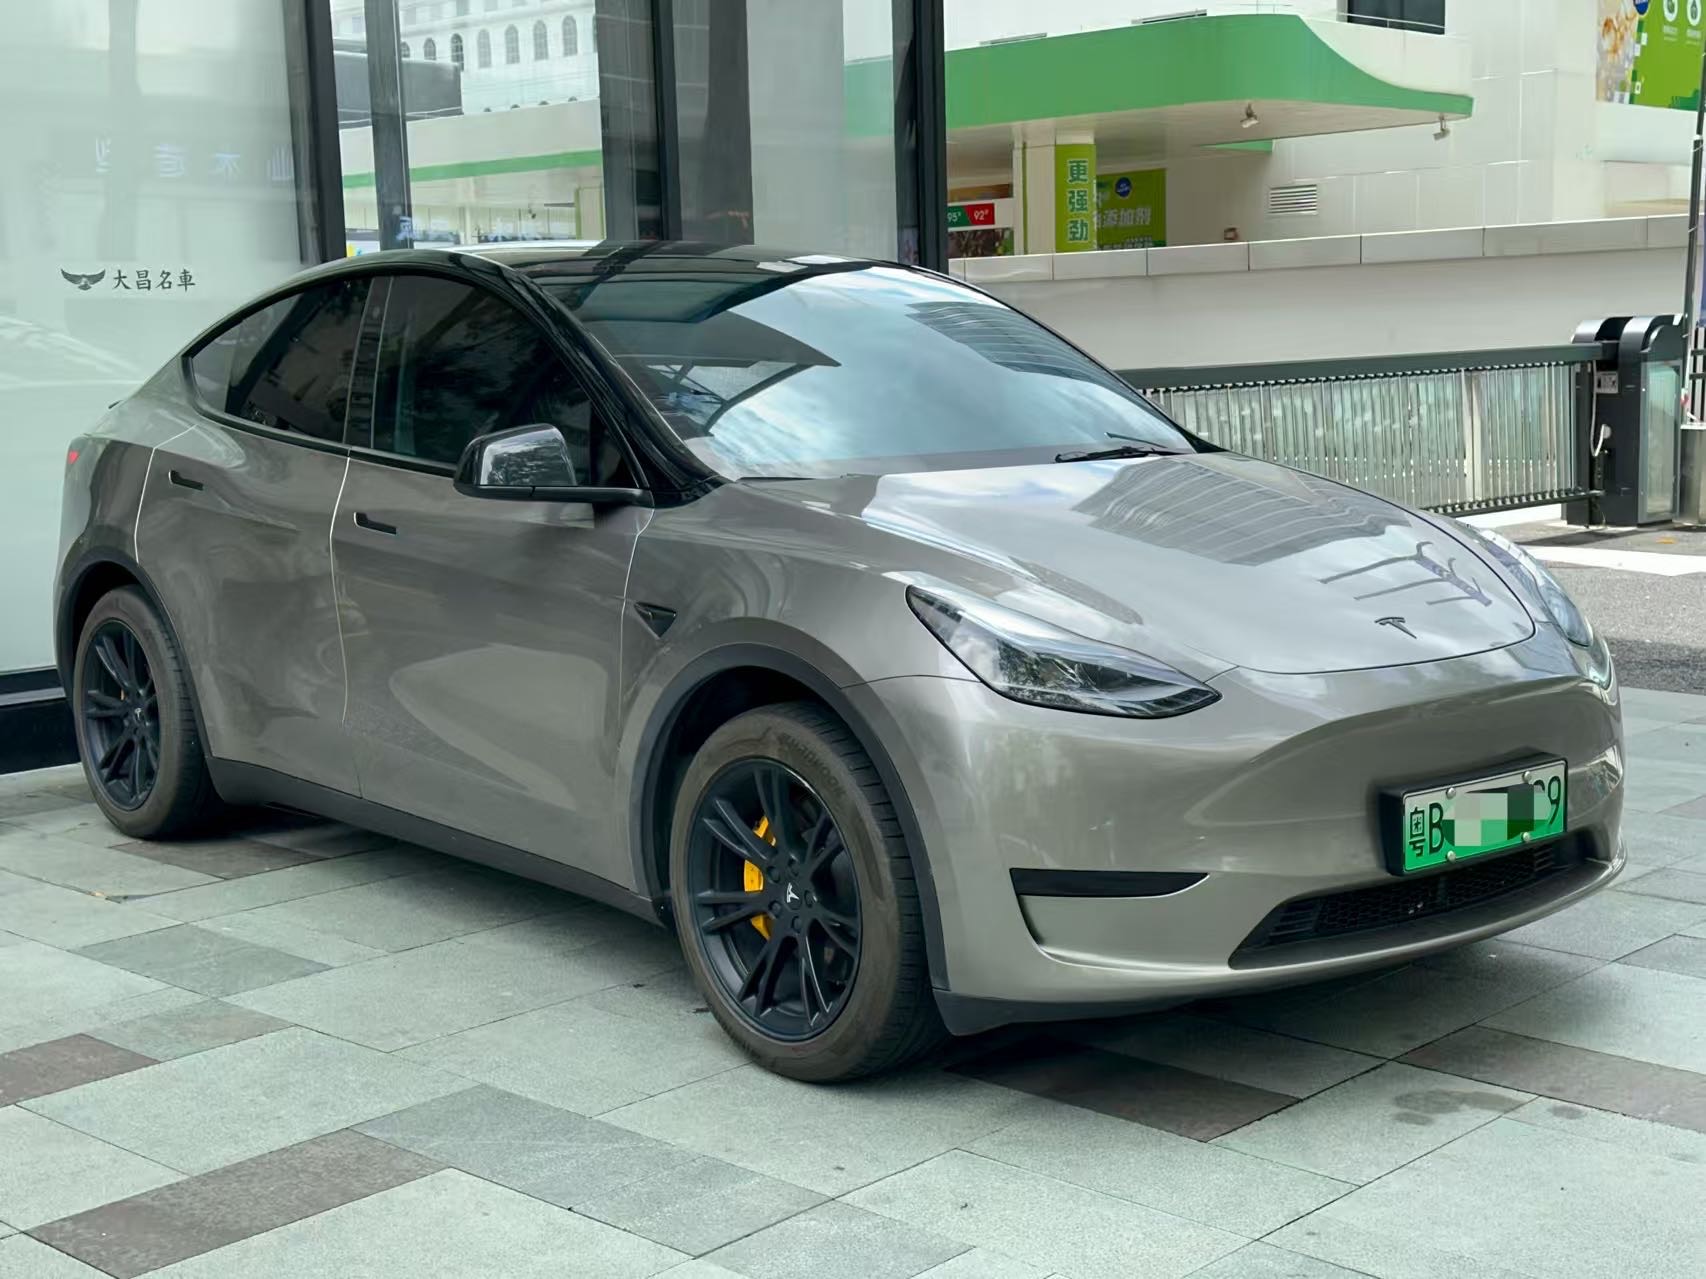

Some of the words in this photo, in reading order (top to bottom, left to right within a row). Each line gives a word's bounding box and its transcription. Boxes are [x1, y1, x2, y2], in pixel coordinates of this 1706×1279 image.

[1067, 159, 1089, 242] 更强劲
[112, 267, 197, 293] 大昌名車
